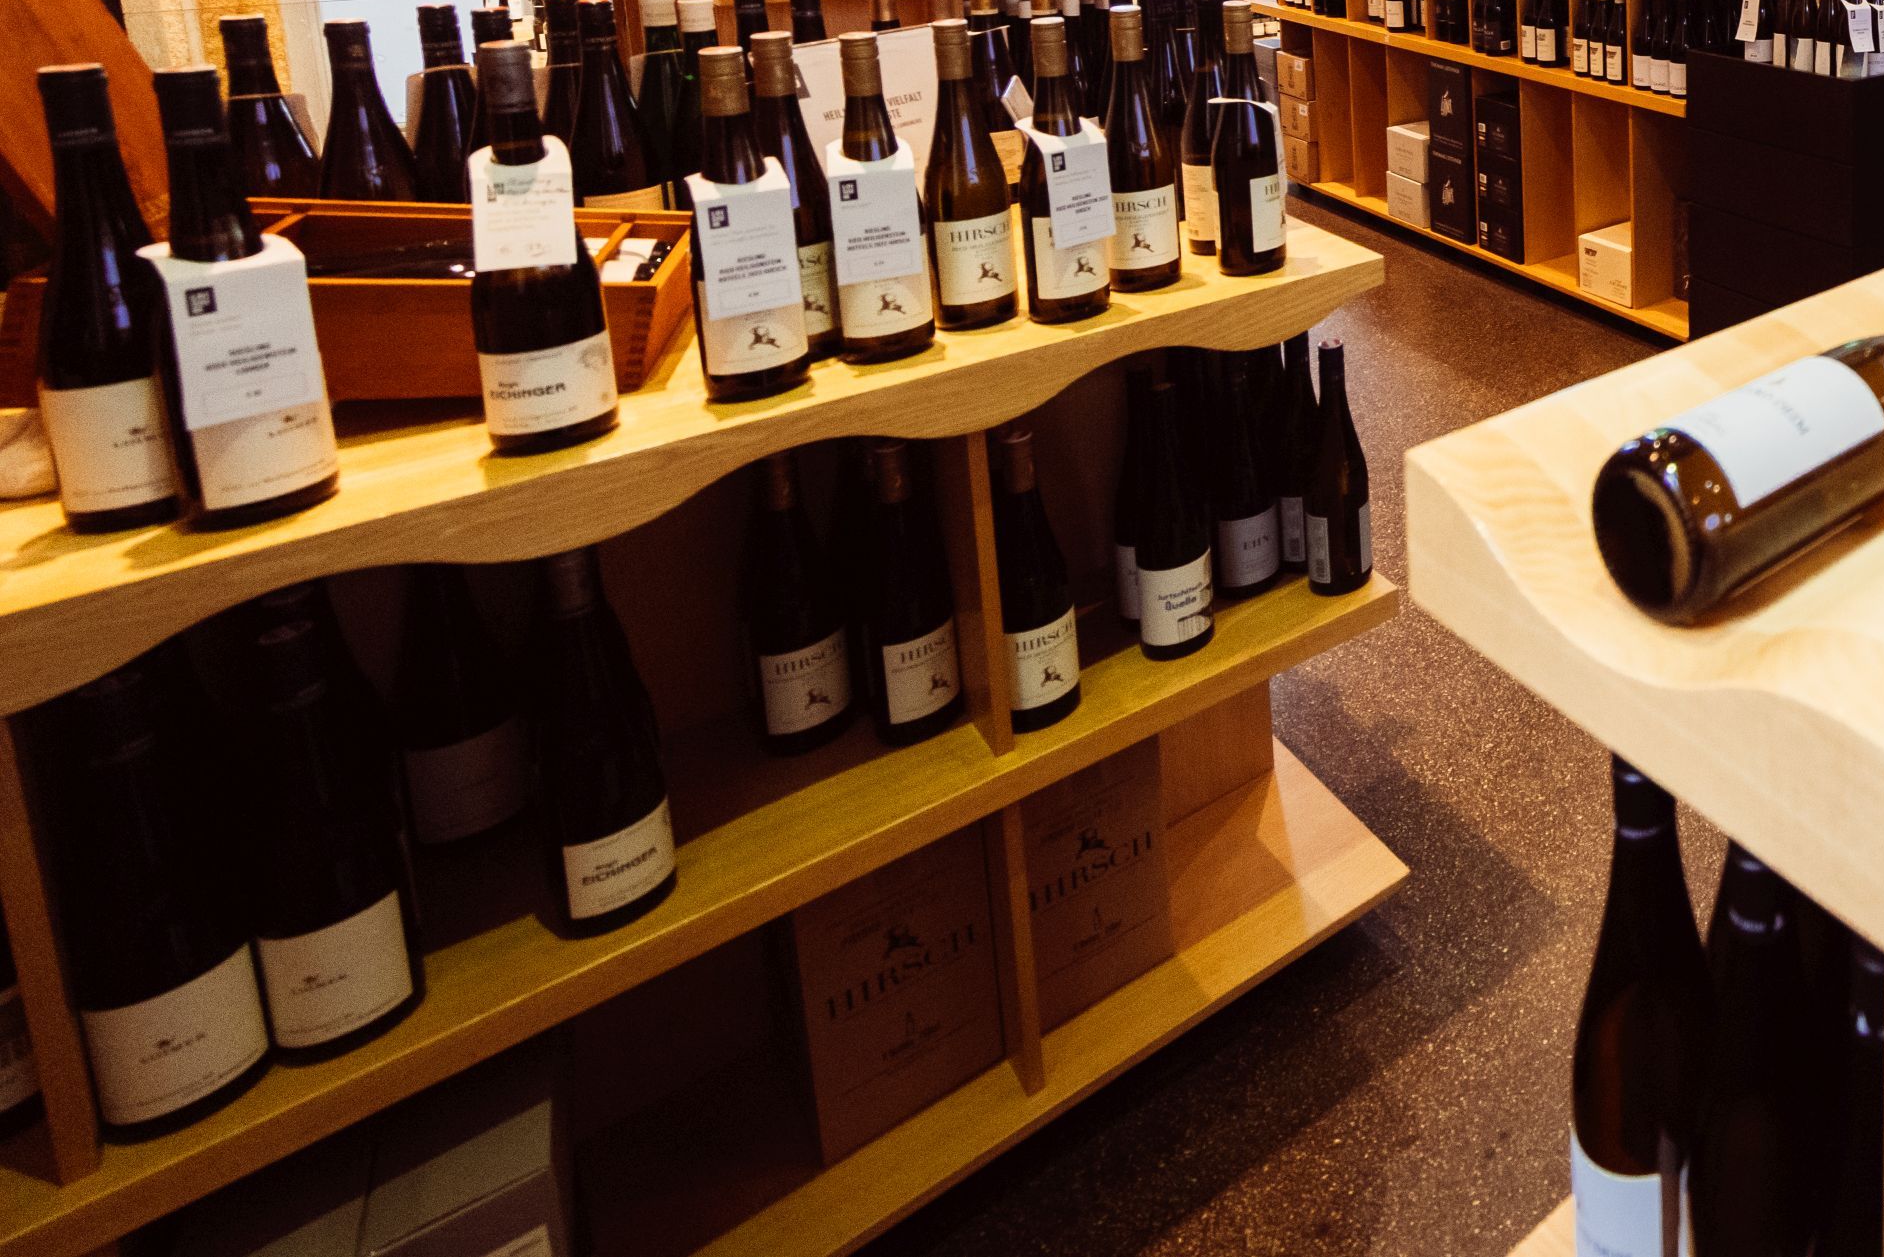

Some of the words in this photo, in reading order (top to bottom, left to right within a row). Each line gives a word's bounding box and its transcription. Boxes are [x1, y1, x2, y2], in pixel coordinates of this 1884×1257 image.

[887, 91, 923, 107] VIELFALT
[1163, 595, 1198, 612] Quelle
[1014, 618, 1074, 654] HIRSCH
[581, 845, 659, 887] EICHINGER
[1028, 830, 1153, 912] HIRSCH
[826, 922, 975, 1020] HIRSCH
